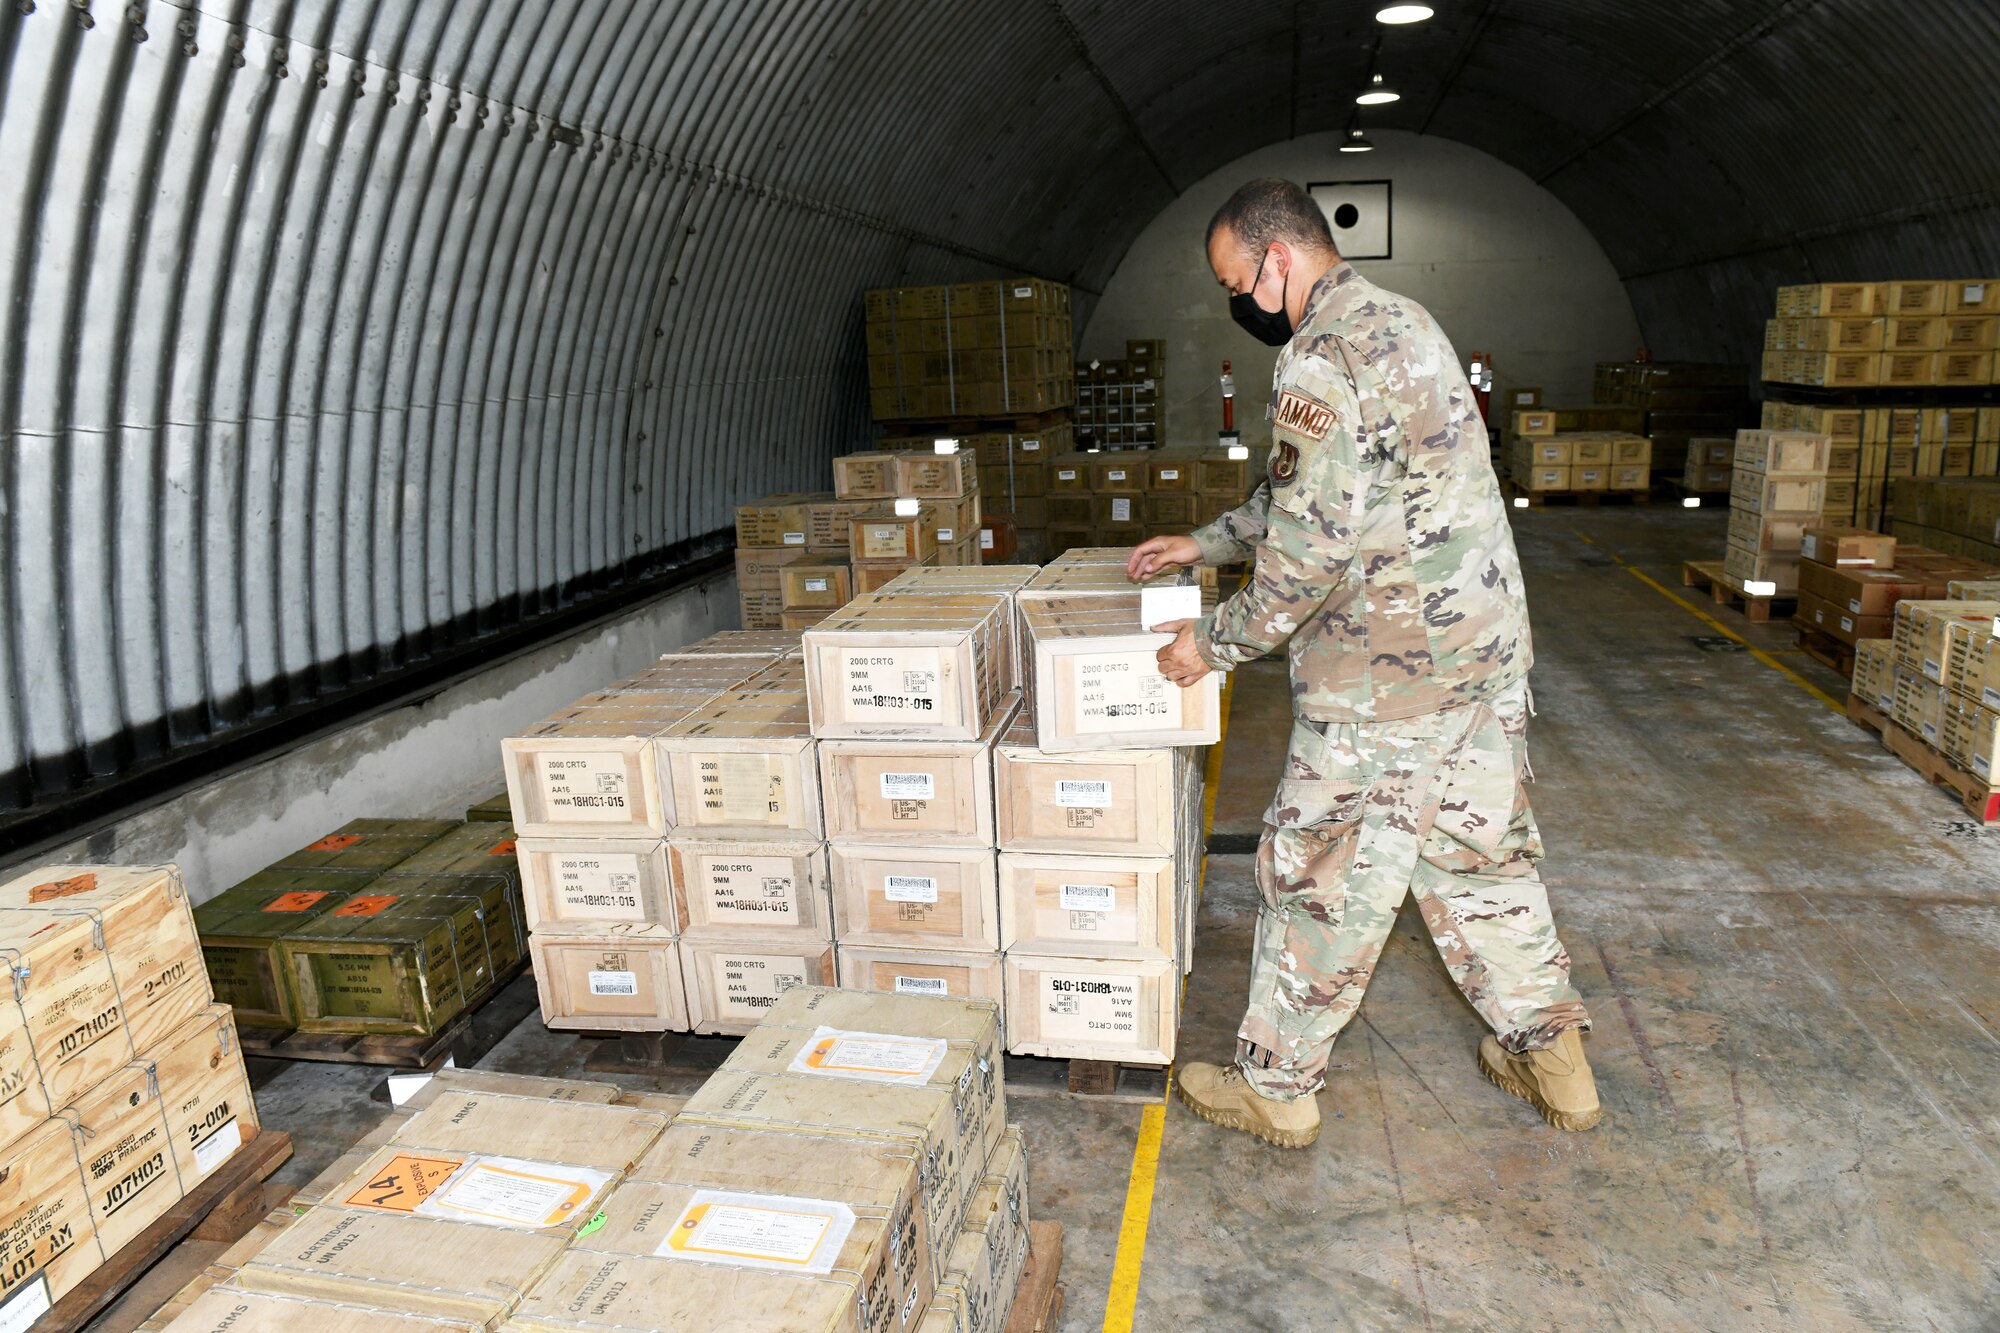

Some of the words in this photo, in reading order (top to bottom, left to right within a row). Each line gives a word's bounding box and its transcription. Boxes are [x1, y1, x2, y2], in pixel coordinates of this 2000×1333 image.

[1280, 397, 1329, 435] AMMO
[850, 671, 869, 679] 9MM
[1082, 665, 1101, 673] 2000
[1104, 663, 1129, 672] CRTG
[1082, 680, 1101, 688] 9MM
[1083, 693, 1105, 701] AA16
[144, 961, 186, 998] 2-001
[807, 993, 825, 1010] ARMS
[56, 1006, 119, 1059] J07H03
[1088, 1021, 1111, 1029] CRTG
[1114, 1023, 1132, 1031] 2000
[767, 1039, 791, 1060] SMALL
[188, 1101, 229, 1142] 2-001
[451, 1101, 478, 1125] ARMS
[118, 1127, 157, 1161] PRACTICE
[688, 1135, 711, 1158] ARMS
[102, 1152, 164, 1211] J07H03
[368, 1175, 404, 1205] 1.4
[410, 1162, 428, 1197] EXPLOSIVE
[32, 1221, 53, 1240] LBS
[633, 1201, 664, 1232] SMALL
[316, 1251, 337, 1265] UN
[334, 1232, 361, 1252] 0012
[868, 1257, 886, 1305] CRTG
[211, 1304, 249, 1333] ARMS
